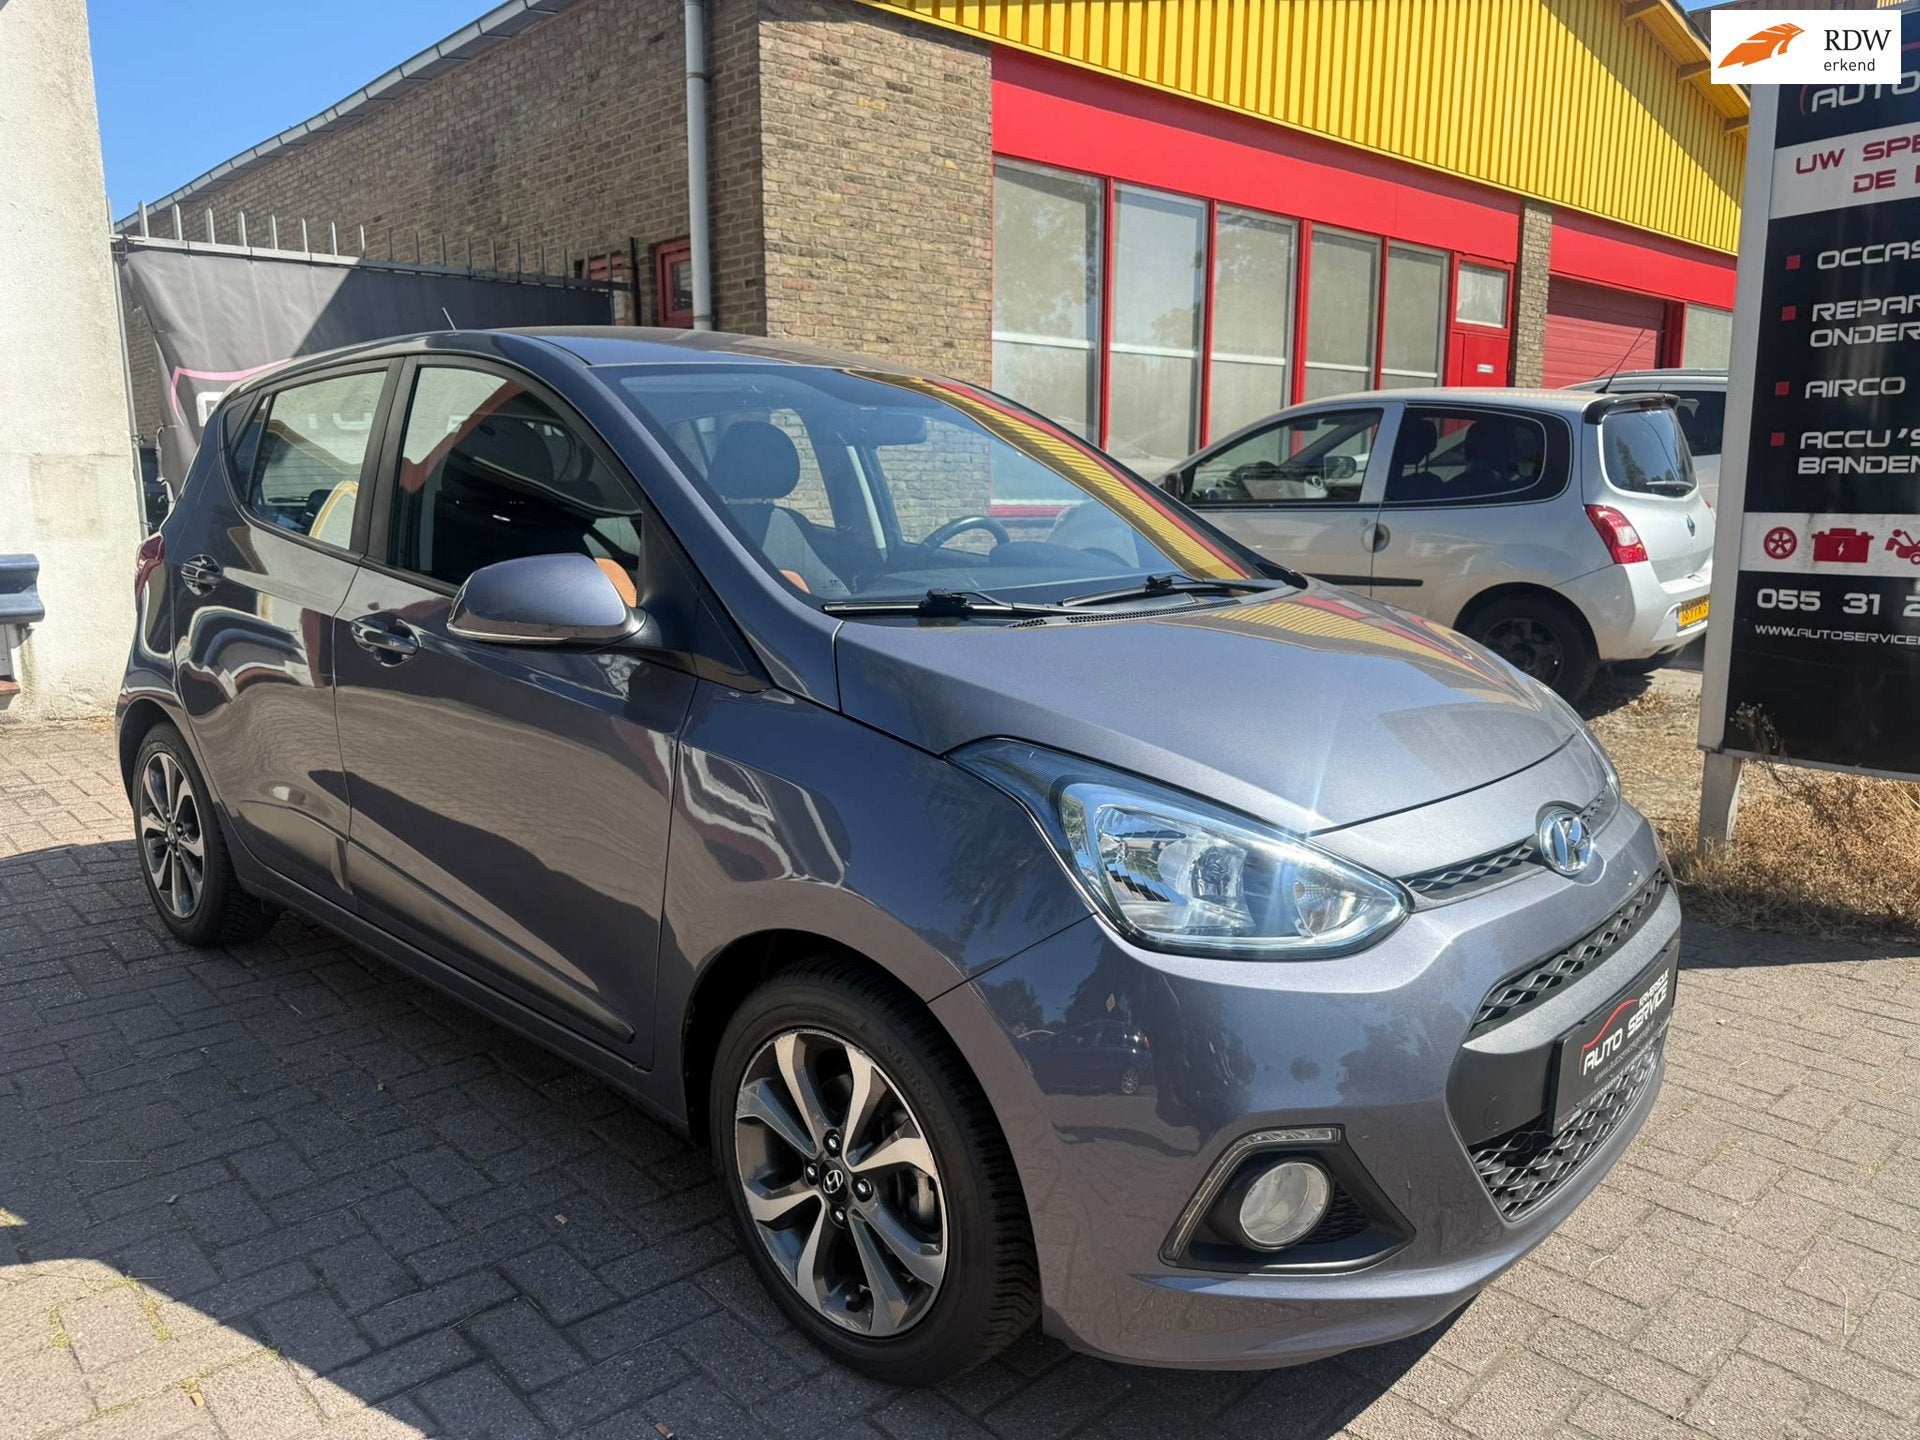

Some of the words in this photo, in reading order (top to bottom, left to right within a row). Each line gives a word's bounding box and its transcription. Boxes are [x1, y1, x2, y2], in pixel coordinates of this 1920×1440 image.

[1796, 148, 1845, 174] UW
[1853, 168, 1897, 193] DE
[1810, 322, 1920, 348] ONDER
[1805, 376, 1906, 399] AIRCO
[1757, 588, 1821, 611] 055
[1842, 592, 1881, 615] 31
[1755, 624, 1920, 646] WWW.AUTOSERVICE
[1583, 1027, 1623, 1076] AUTO
[1627, 979, 1668, 1039] SERVICE
